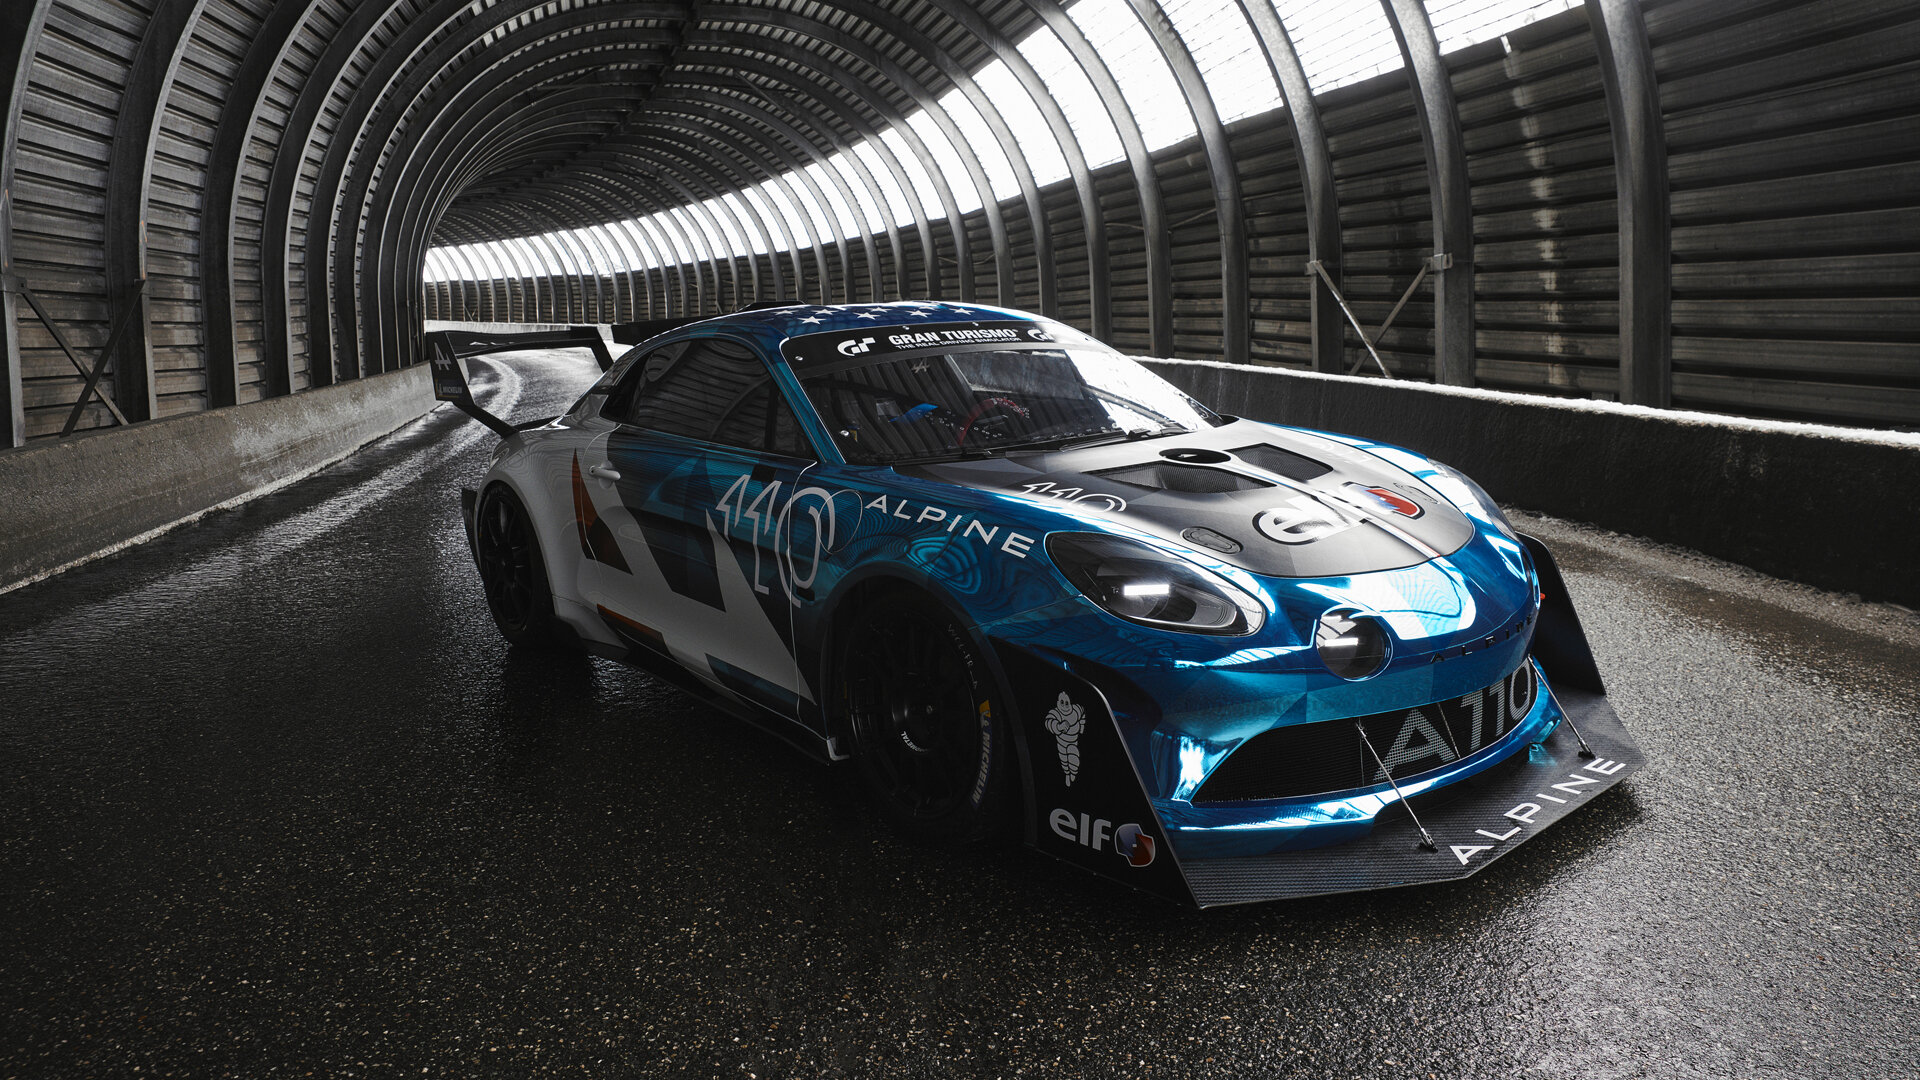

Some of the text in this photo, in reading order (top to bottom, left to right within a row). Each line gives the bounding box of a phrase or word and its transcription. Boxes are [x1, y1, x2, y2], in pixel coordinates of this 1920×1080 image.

[888, 328, 1018, 346] GRAN TURISMO
[940, 338, 975, 346] DRIVING
[976, 336, 1021, 344] SIMULATOR
[716, 474, 835, 608] 110
[865, 494, 1035, 559] ALPINE
[1430, 615, 1532, 664] ALPINE
[1372, 657, 1533, 783] A110
[971, 730, 991, 805] MICHELIN
[1049, 808, 1112, 851] elf
[1450, 757, 1627, 866] ALPINE
